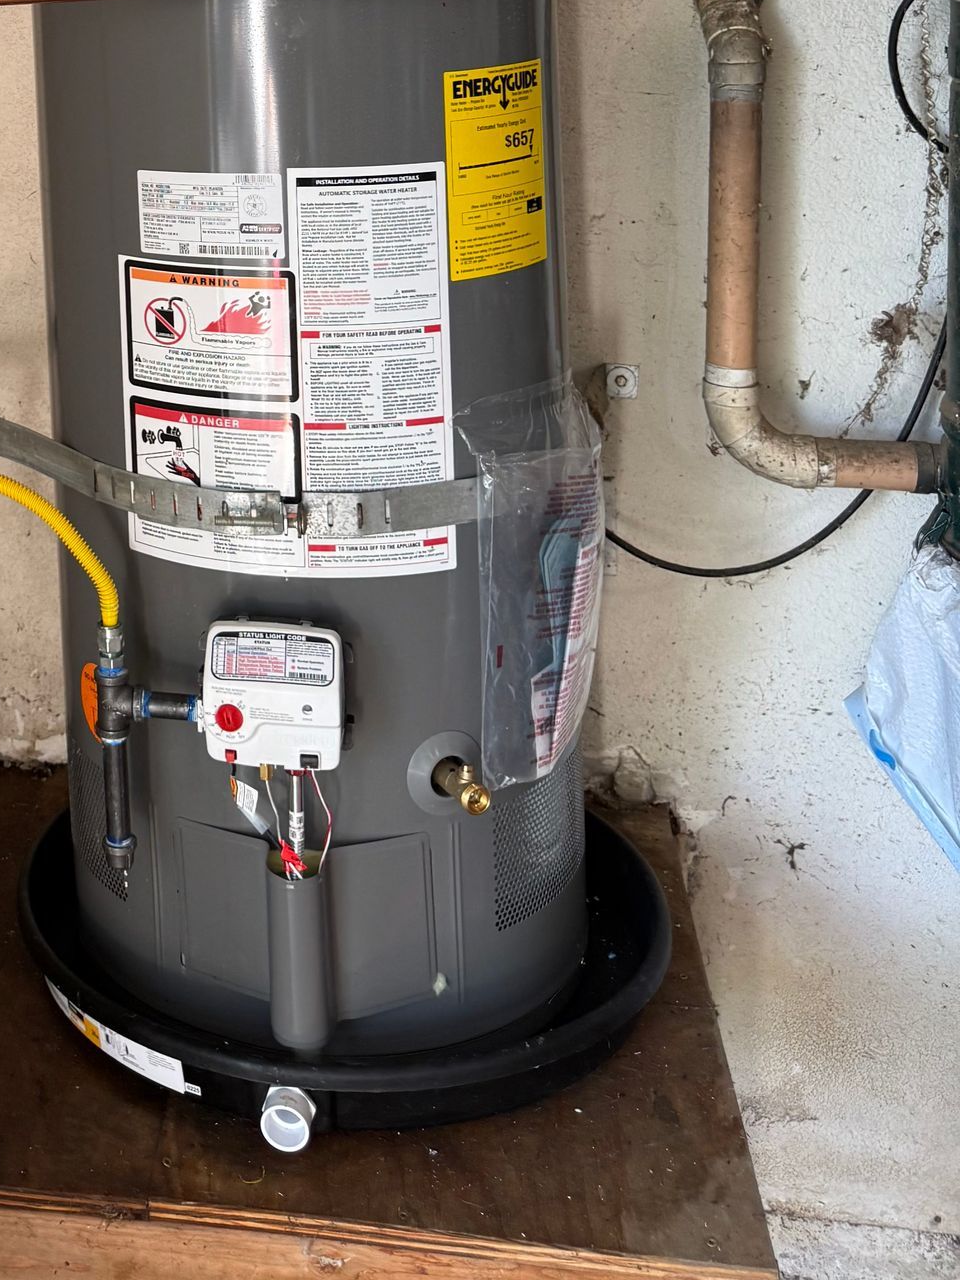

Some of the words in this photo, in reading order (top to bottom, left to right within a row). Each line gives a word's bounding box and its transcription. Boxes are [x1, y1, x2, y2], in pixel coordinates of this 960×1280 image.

[505, 128, 534, 148] $657
[182, 276, 239, 287] WARNING
[192, 416, 239, 428] DANGER
